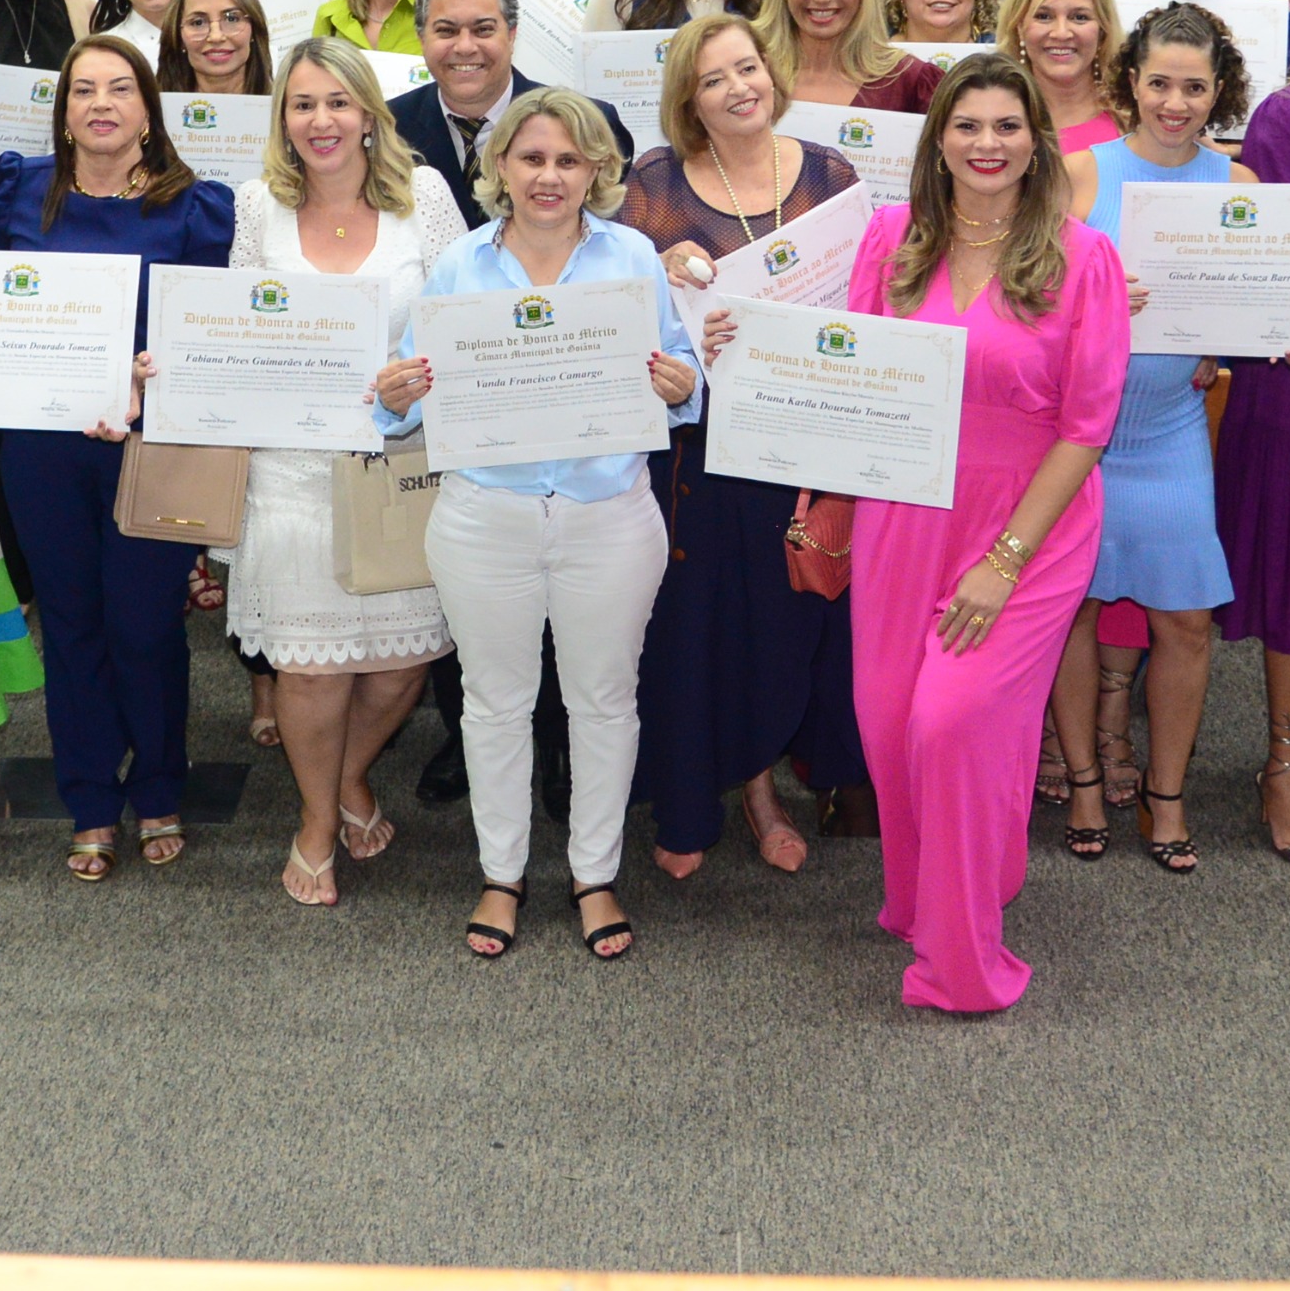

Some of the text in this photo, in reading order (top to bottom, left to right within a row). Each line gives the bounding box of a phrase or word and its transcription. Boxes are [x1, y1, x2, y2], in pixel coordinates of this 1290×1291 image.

[604, 69, 644, 78] Diploma
[240, 133, 267, 144] Méri
[209, 169, 229, 177] Silva
[871, 191, 882, 199] de
[1169, 272, 1196, 280] Gisele
[1199, 272, 1225, 280] Paula
[1227, 273, 1238, 281] de
[1240, 273, 1267, 282] Souza
[185, 312, 355, 330] Diploma de Honra ao Mérito
[455, 340, 503, 350] Diploma
[506, 337, 518, 346] de
[522, 334, 558, 344] Honra
[579, 327, 616, 339] Mérito
[29, 342, 65, 350] Dourado
[68, 343, 106, 352] Tomazetti
[474, 352, 507, 361] Câmara
[511, 347, 552, 359] Municipal
[567, 343, 600, 352] Goiânia
[186, 354, 223, 363] Fabiana
[226, 356, 248, 364] Pires
[252, 357, 301, 366] Guimarães
[320, 359, 349, 367] Morais
[749, 348, 924, 382] Diploma de Honra ao Mérito
[477, 371, 602, 387] Vanda Francisco Camargo
[771, 367, 897, 391] Câmara Municipal de Goiânia
[755, 391, 784, 403] Bruna
[820, 401, 861, 414] Dourado
[866, 407, 910, 420] Tomazetti
